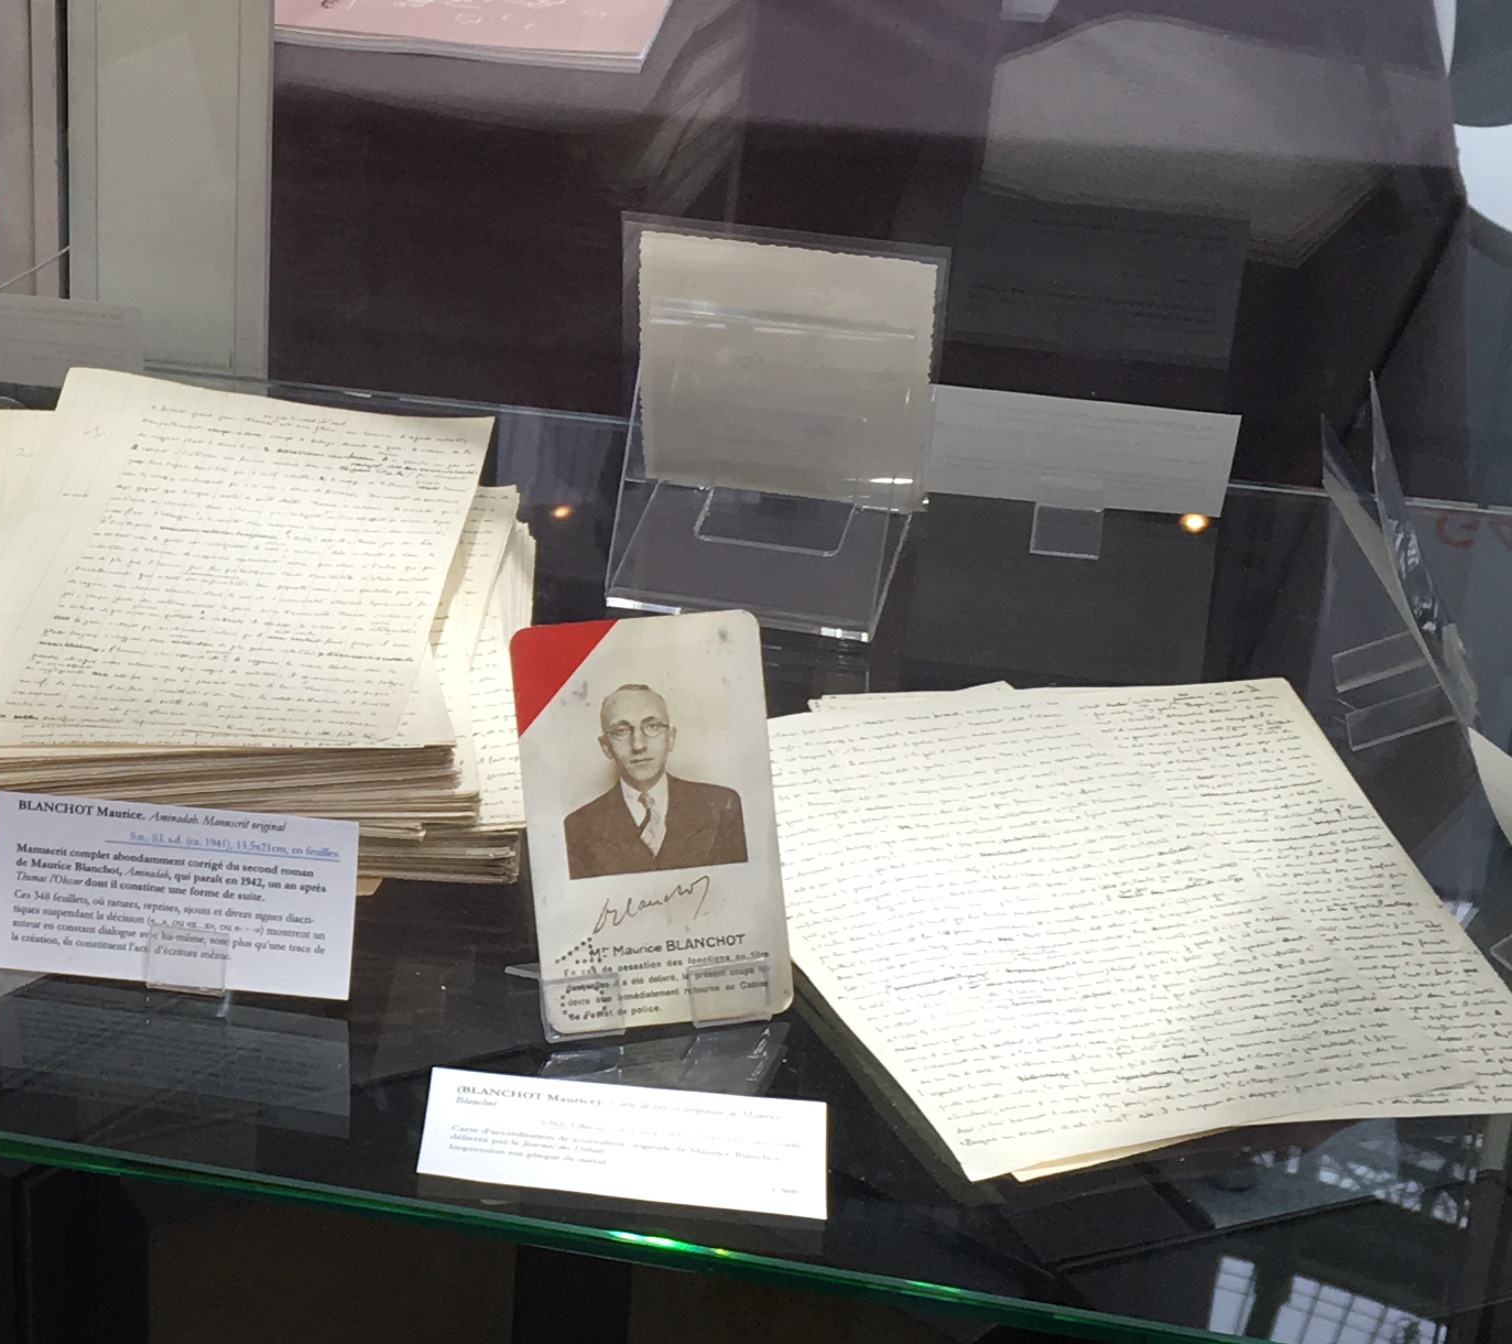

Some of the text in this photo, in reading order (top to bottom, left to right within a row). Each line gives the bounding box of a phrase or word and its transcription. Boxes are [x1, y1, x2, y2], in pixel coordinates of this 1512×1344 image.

[18, 799, 95, 816] BLANCHOT
[96, 805, 146, 821] Maurice.
[251, 822, 287, 834] original
[16, 842, 315, 878] Manuscrit complet abondamment corrigé du second roman
[612, 943, 663, 958] Maurice
[665, 933, 747, 953] BLANCHOT
[456, 1085, 544, 1102] (BLANCHOT
